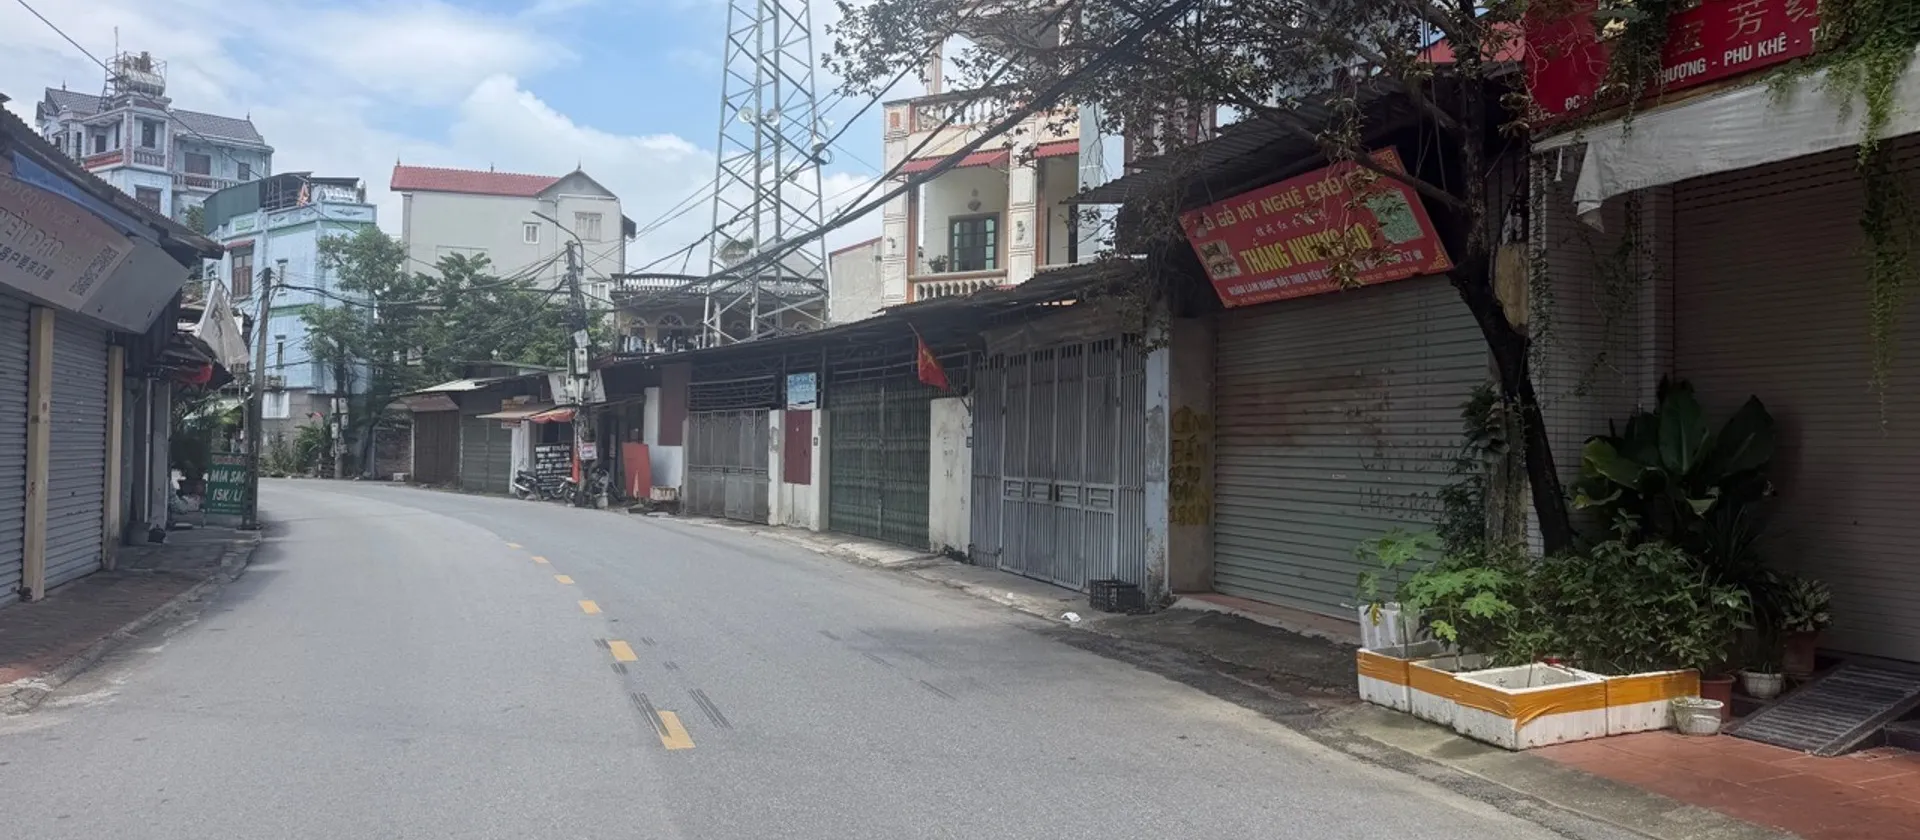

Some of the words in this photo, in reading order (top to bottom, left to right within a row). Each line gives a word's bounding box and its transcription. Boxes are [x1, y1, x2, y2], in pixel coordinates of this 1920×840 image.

[1723, 40, 1753, 67] PHÙ
[1757, 32, 1788, 58] KHÊ
[1305, 177, 1343, 202] CAO
[210, 466, 229, 482] MÍA
[229, 470, 247, 486] SẠC
